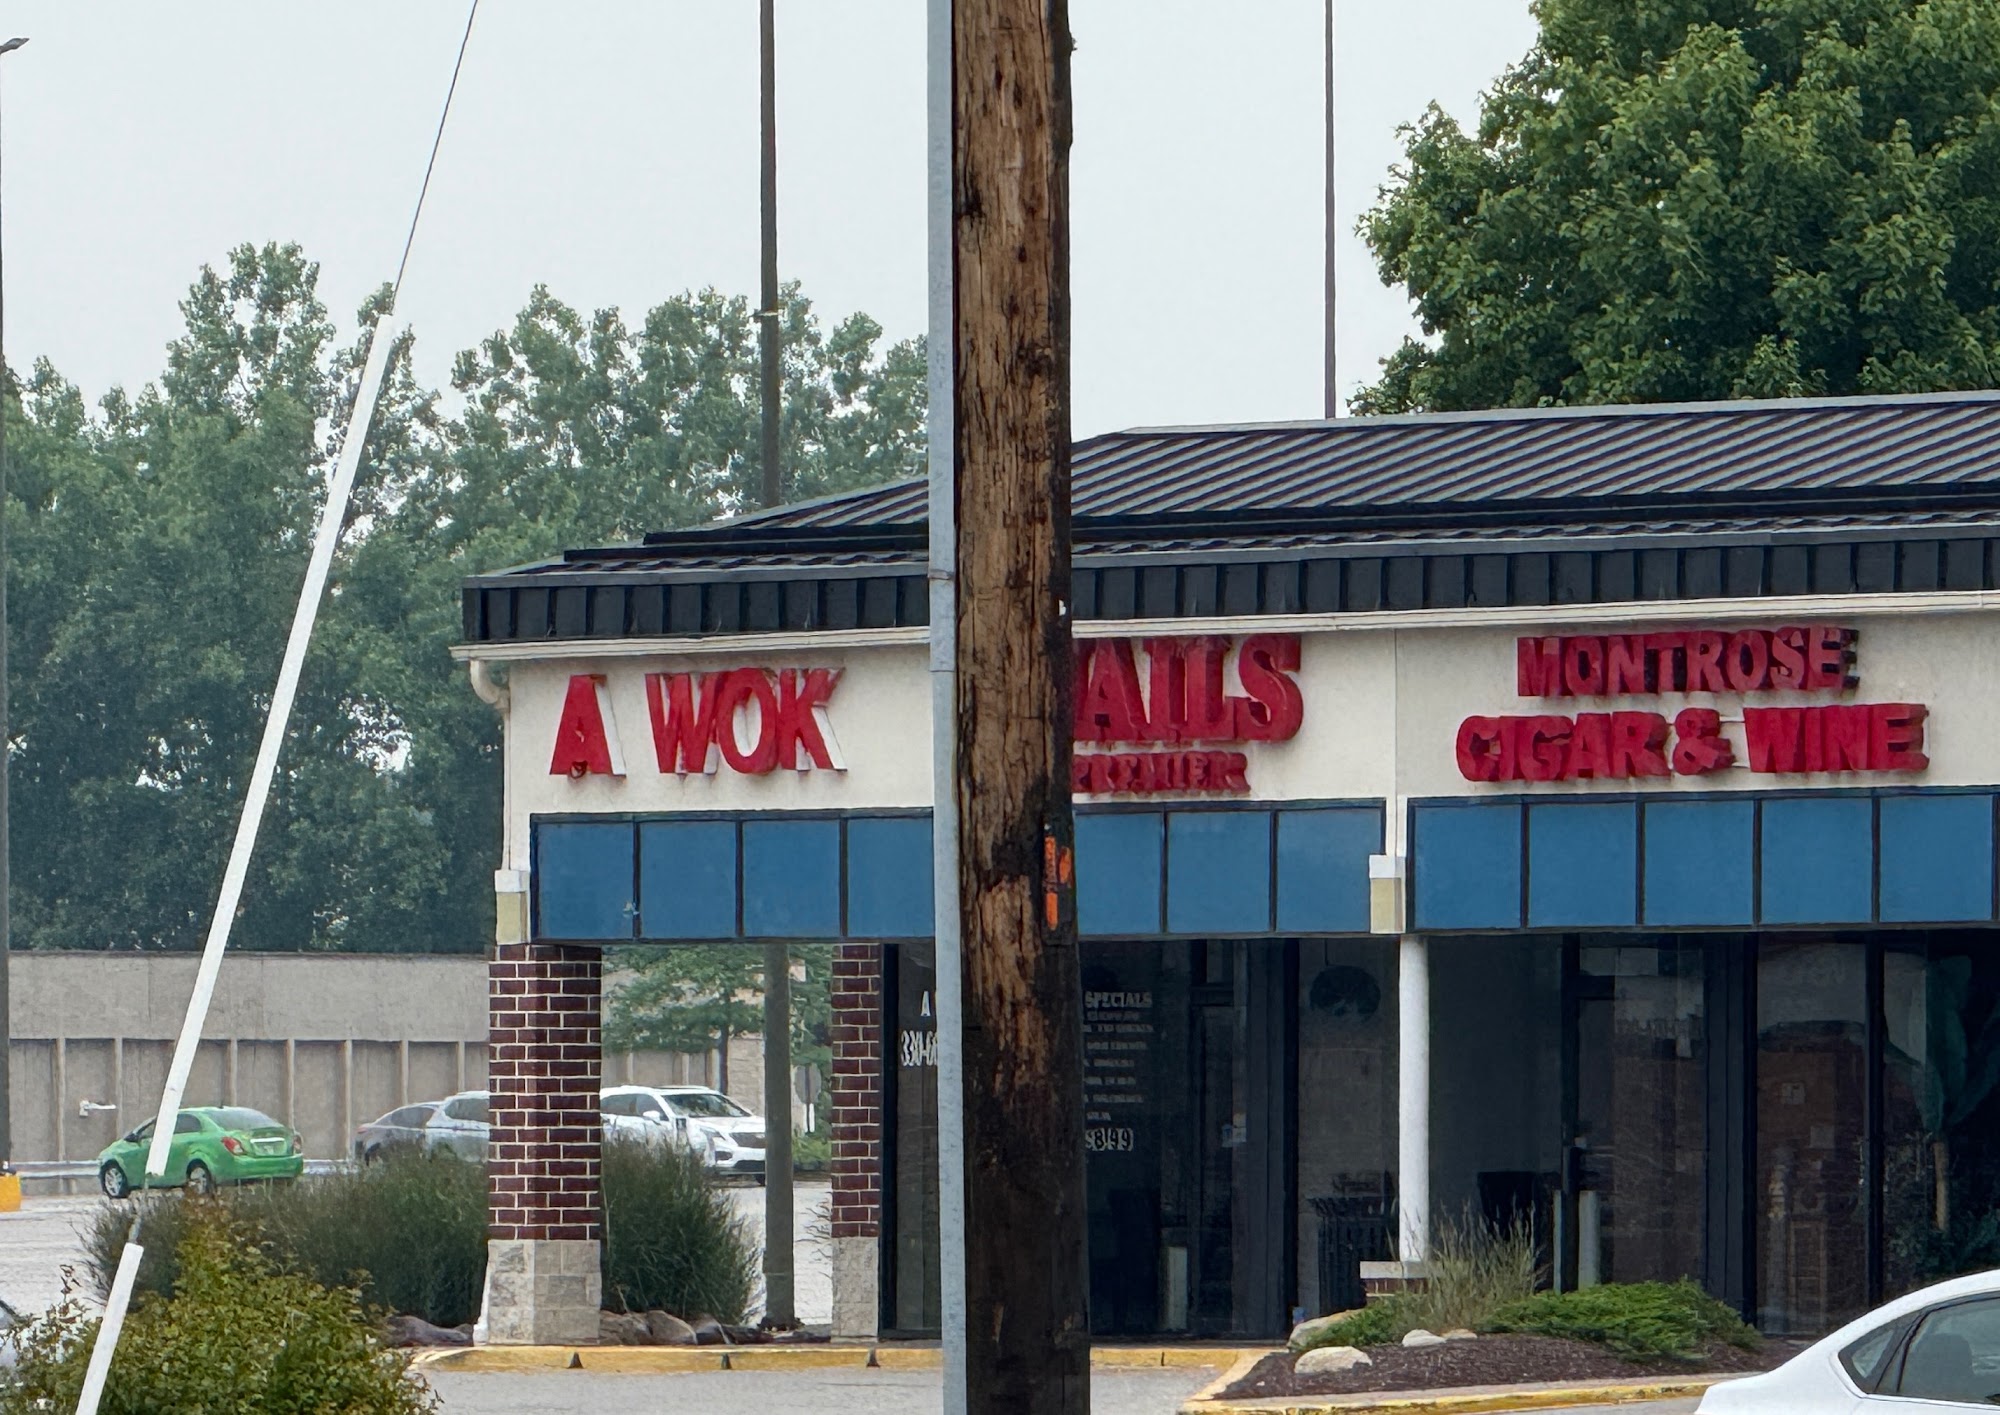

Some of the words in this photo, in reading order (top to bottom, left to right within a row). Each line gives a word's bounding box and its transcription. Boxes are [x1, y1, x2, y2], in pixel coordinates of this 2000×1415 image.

[1074, 633, 1304, 742] AILS
[1517, 627, 1859, 696] MONTROSE
[549, 673, 627, 777] A
[645, 667, 847, 775] WOK
[1456, 710, 1672, 783] CIGAR
[1672, 707, 1736, 775] &
[1742, 703, 1931, 774] WINE
[1085, 991, 1152, 1008] SPECIALS
